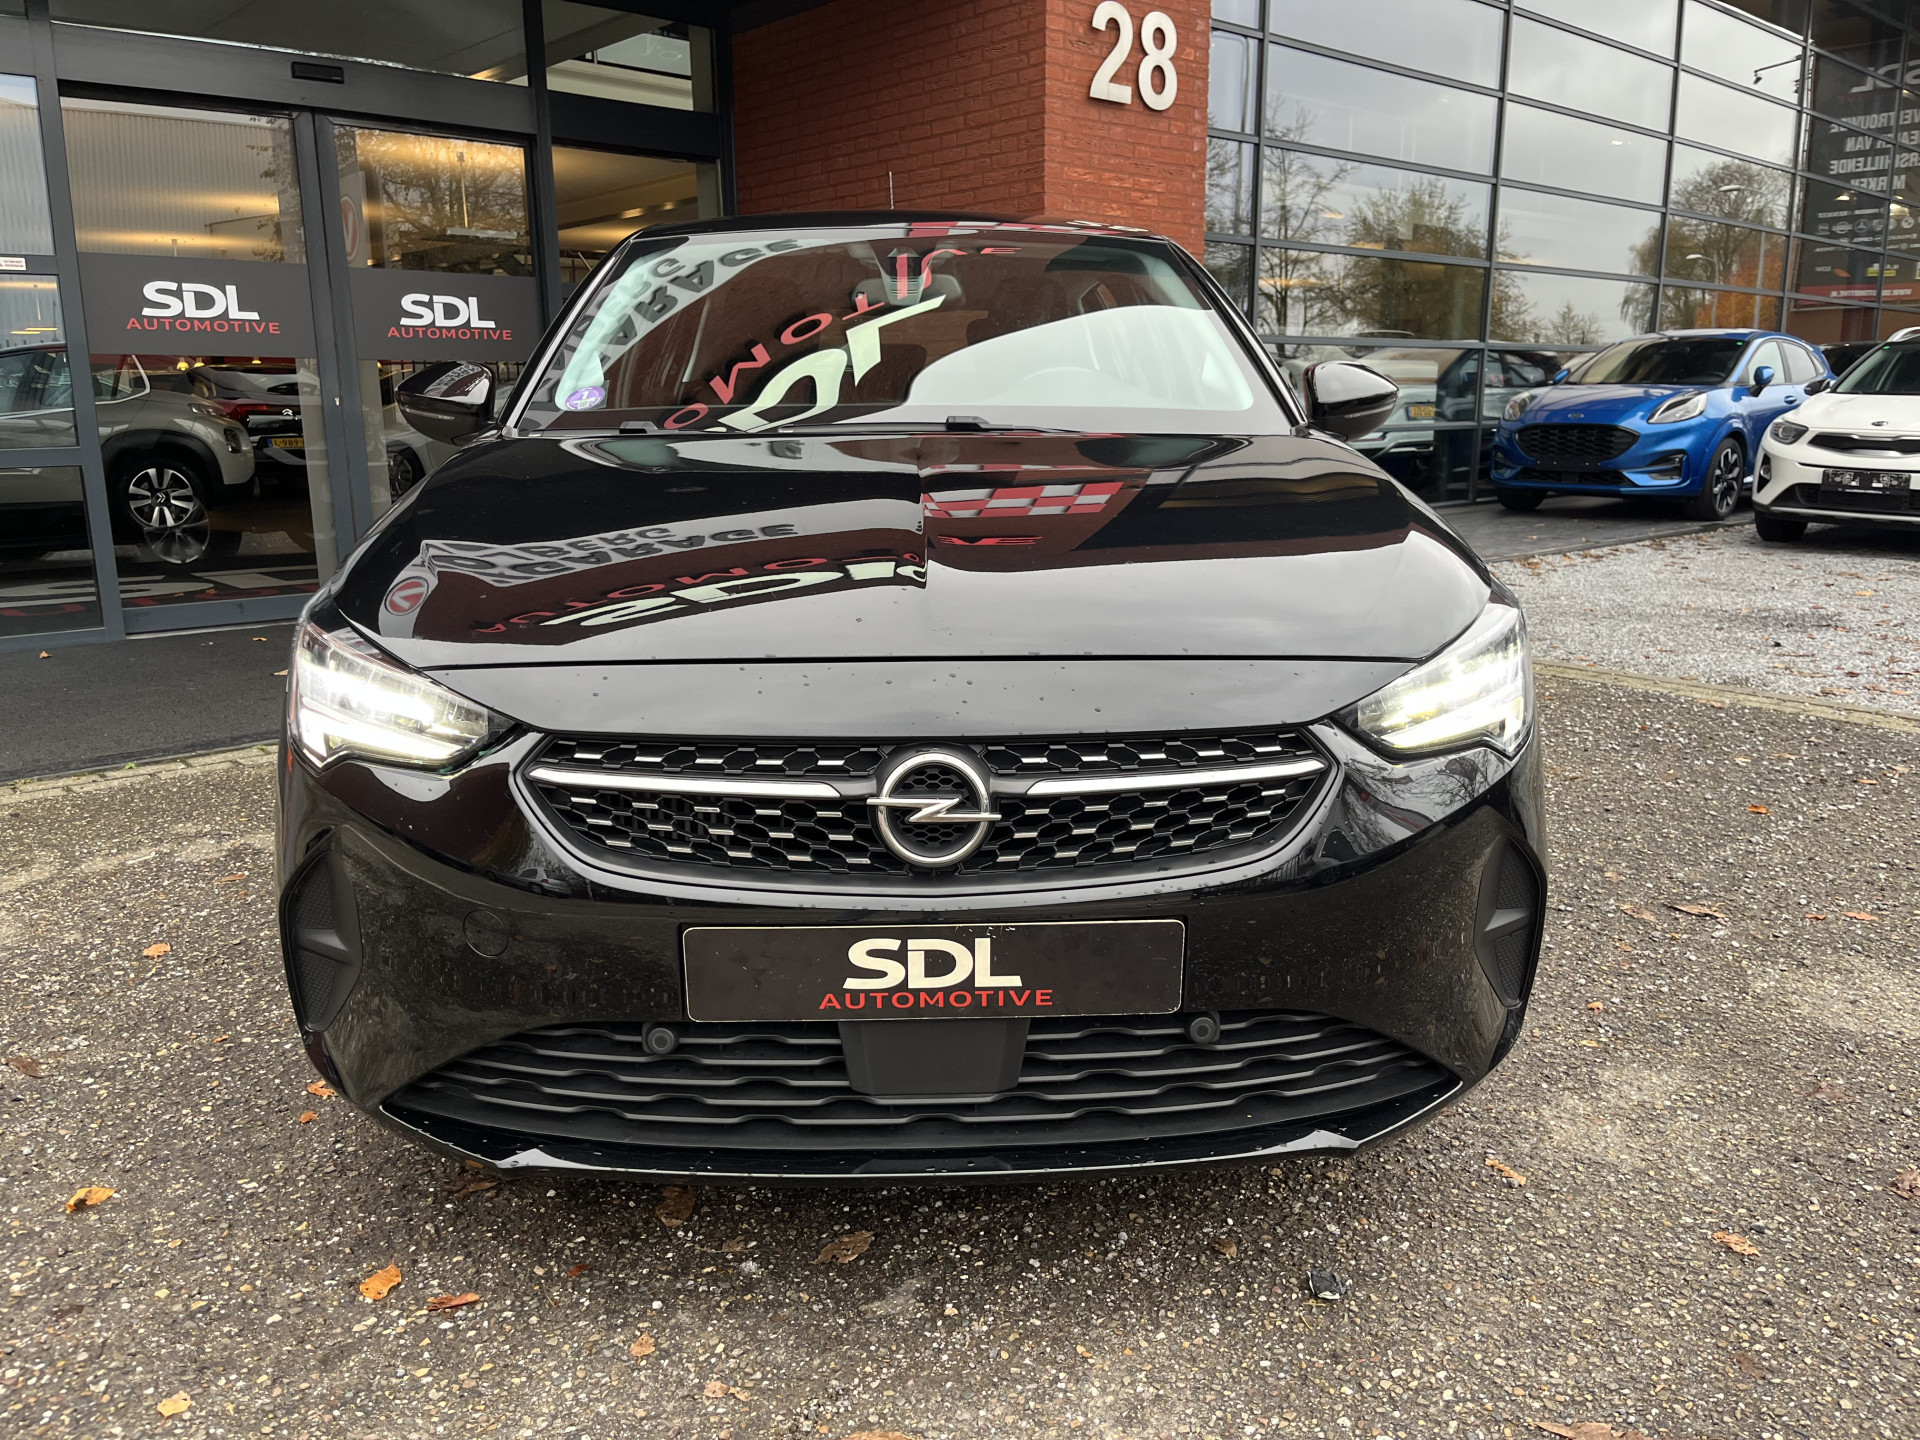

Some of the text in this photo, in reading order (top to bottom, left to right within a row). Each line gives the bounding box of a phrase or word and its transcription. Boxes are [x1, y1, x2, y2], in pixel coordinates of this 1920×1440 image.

[1089, 0, 1178, 111] 28
[141, 281, 260, 320] SDL
[399, 293, 496, 329] SDL
[126, 316, 281, 335] AUTOMOTIVE
[387, 326, 513, 341] AUTOMOTIVE
[842, 937, 1023, 990] SDL
[818, 989, 1053, 1010] AUTOMOTIVE
